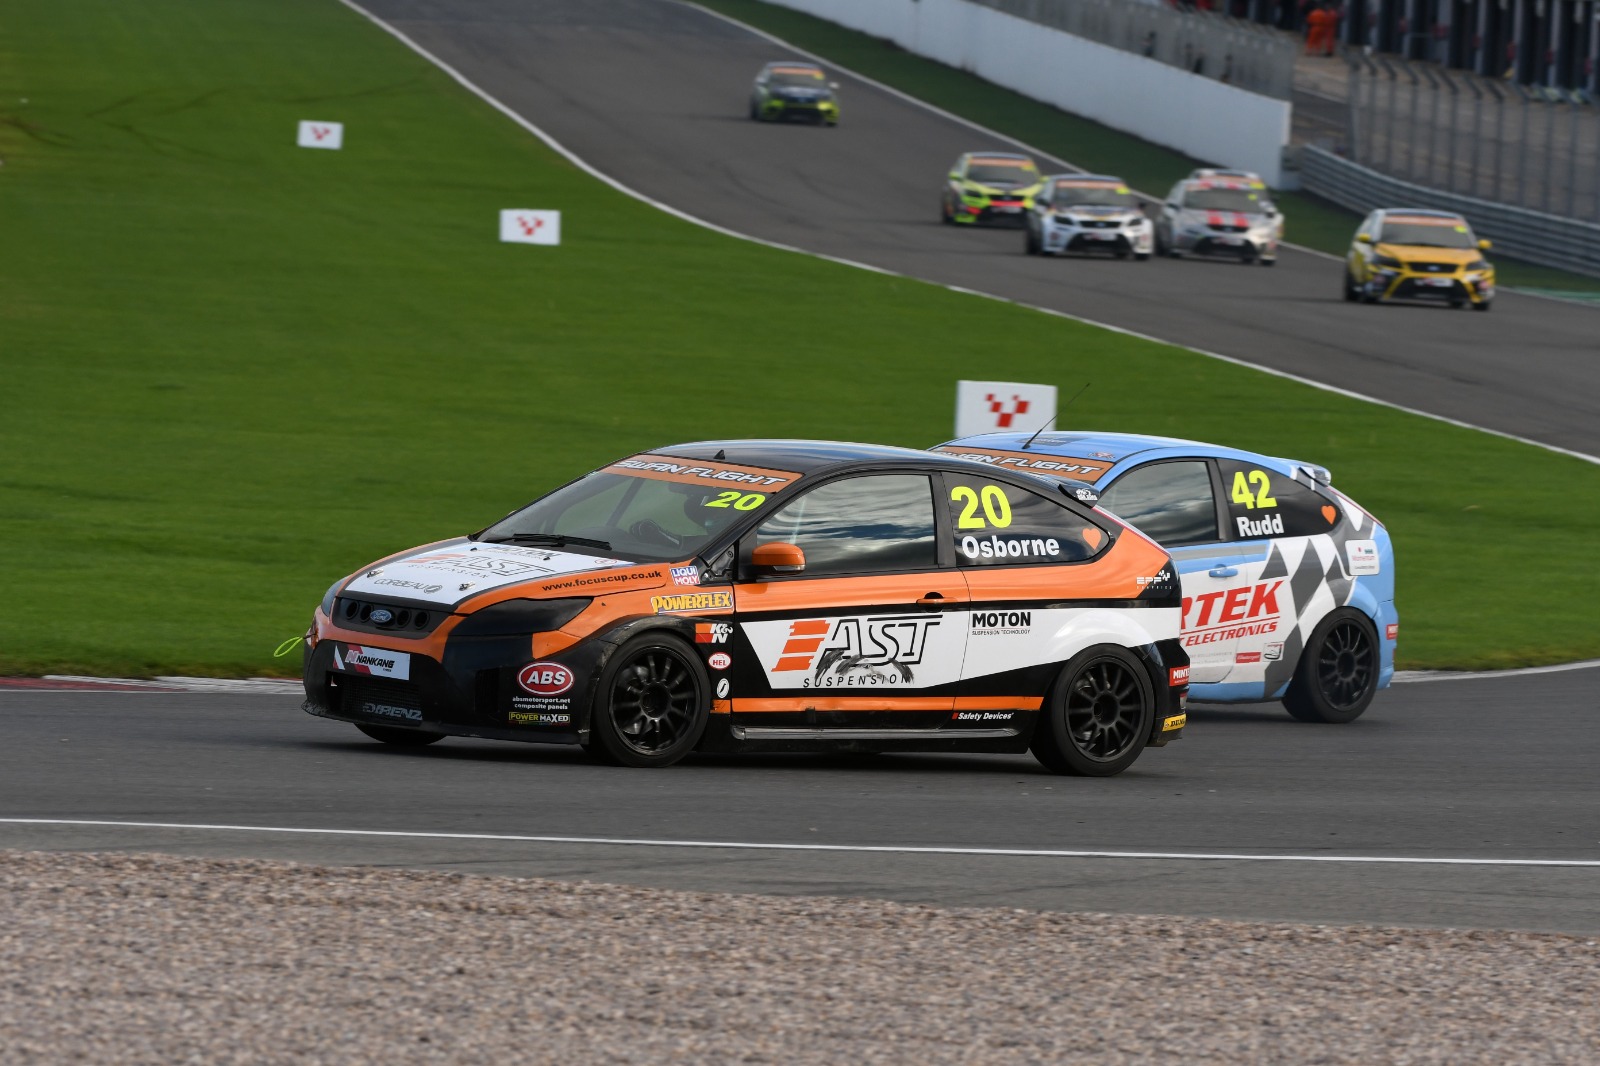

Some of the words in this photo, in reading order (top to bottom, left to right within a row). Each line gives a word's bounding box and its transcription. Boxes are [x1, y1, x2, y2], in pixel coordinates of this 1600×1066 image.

[998, 456, 1101, 474] FLIGHT
[682, 466, 787, 485] FLIGHT
[1231, 470, 1278, 510] 42
[704, 491, 766, 511] 20
[950, 485, 1012, 529] 20
[1236, 513, 1284, 537] Rudd
[962, 535, 1060, 559] Osborne
[541, 569, 663, 592] www.focuscup.co.uk
[671, 566, 697, 577] LIQUI
[674, 575, 699, 585] MOLY
[652, 592, 731, 613] POWERFLEX
[972, 611, 1031, 628] MOTON
[1185, 621, 1278, 647] ELECTRONICS
[356, 655, 396, 669] NANKANG
[712, 659, 728, 667] HEL
[526, 670, 567, 685] ABS
[510, 713, 539, 721] POWER
[958, 712, 982, 721] Safety
